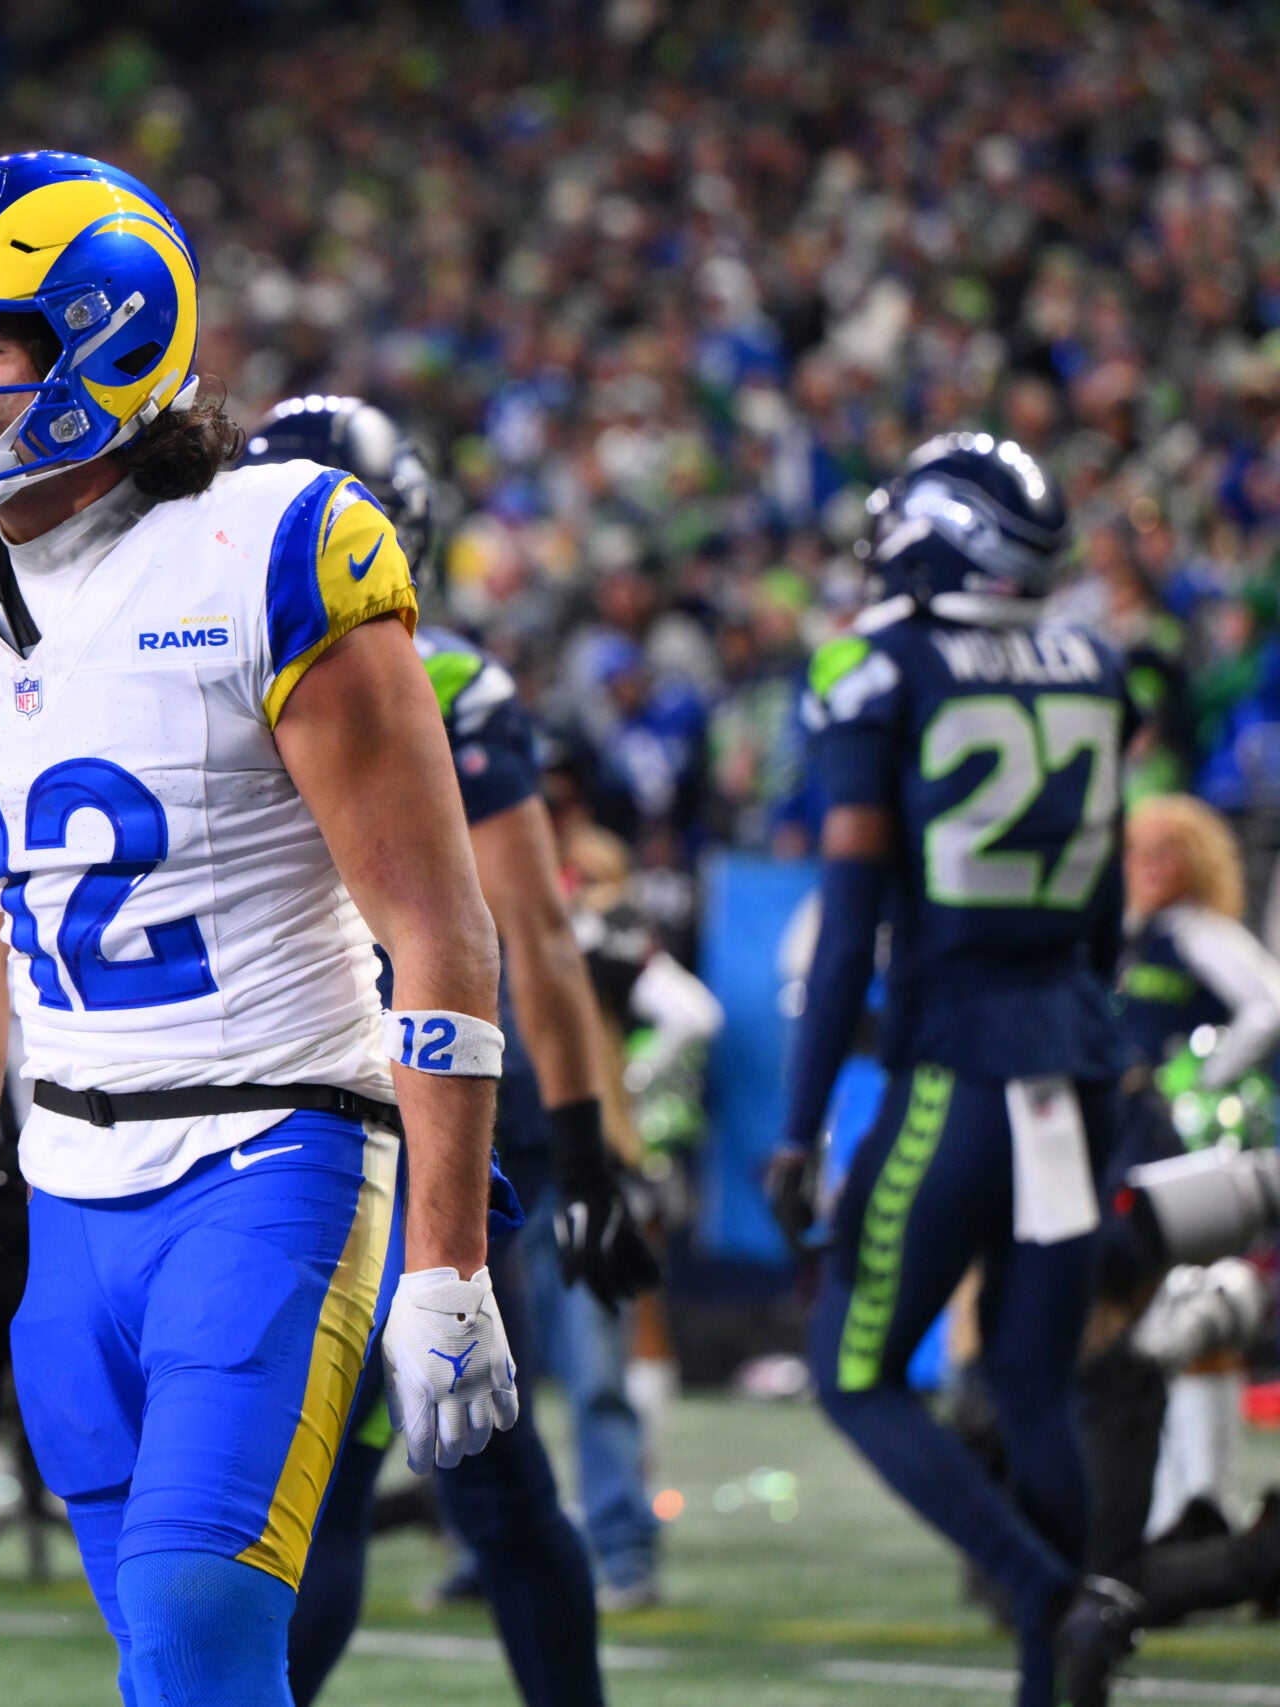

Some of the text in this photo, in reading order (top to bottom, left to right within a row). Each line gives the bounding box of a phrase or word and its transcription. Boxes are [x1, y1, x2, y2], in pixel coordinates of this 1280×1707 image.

[138, 627, 228, 650] RAMS
[17, 692, 38, 711] NFL
[920, 693, 1123, 911] 27
[398, 1016, 456, 1070] 12
